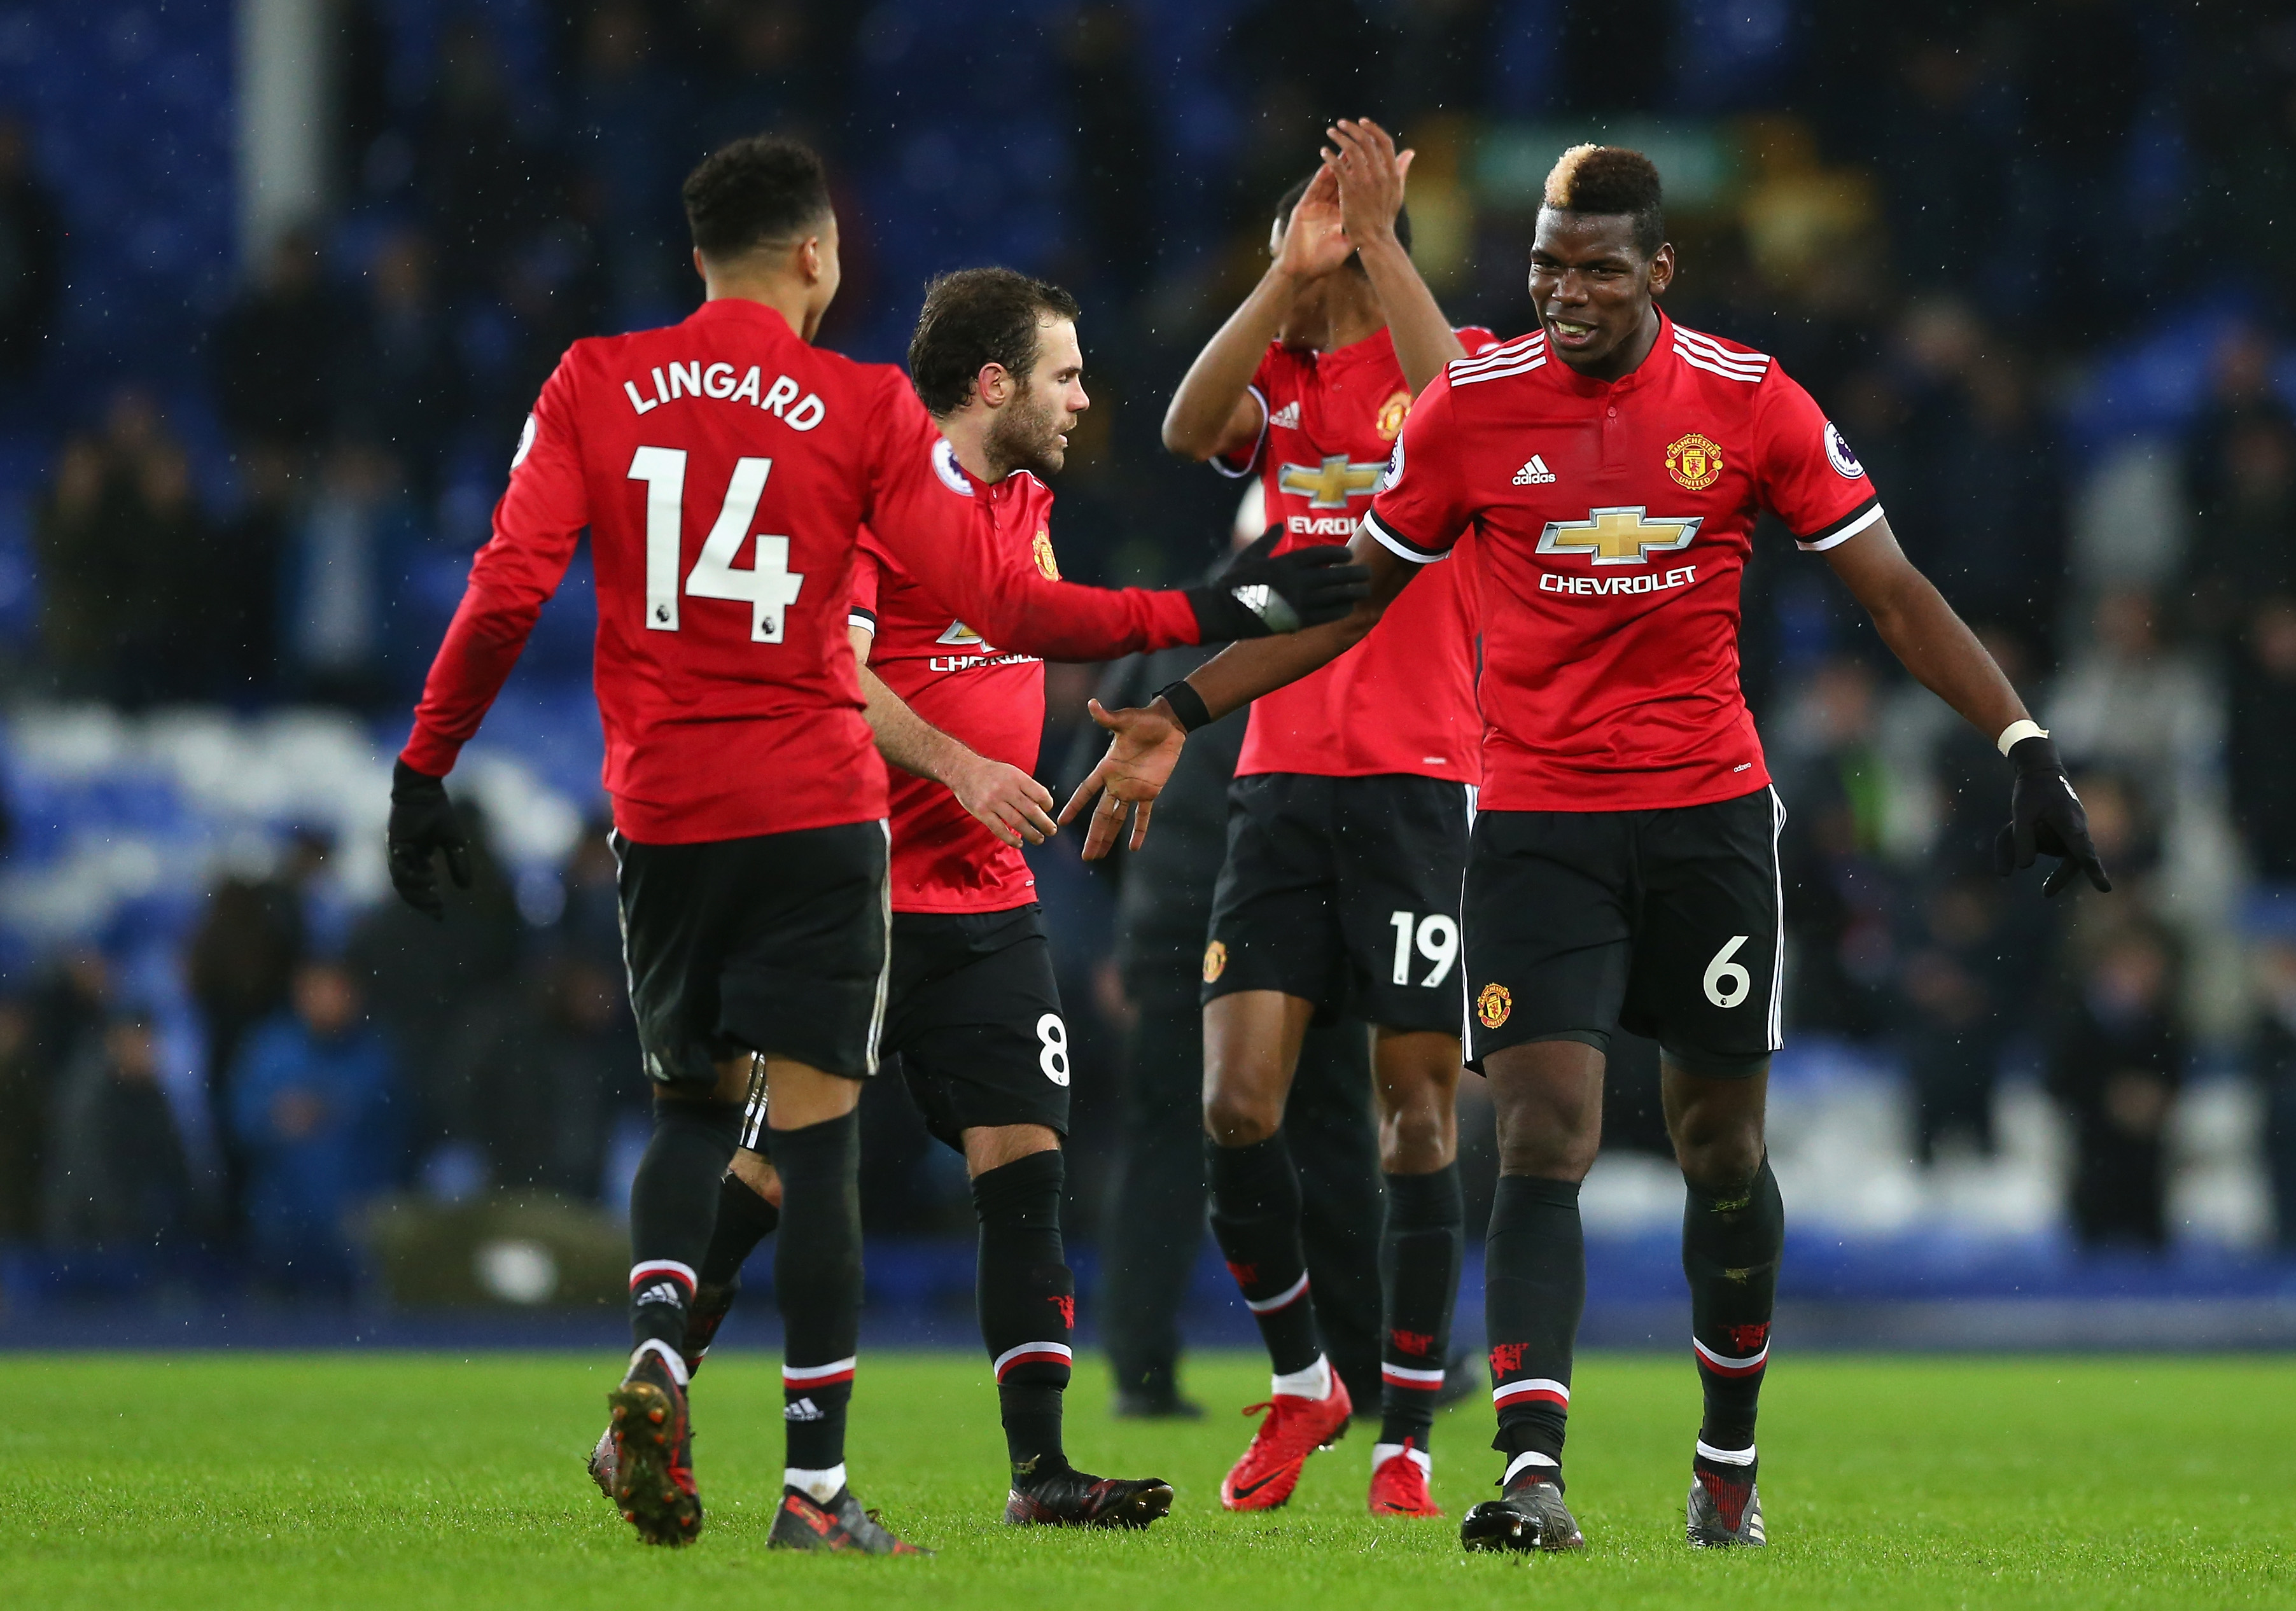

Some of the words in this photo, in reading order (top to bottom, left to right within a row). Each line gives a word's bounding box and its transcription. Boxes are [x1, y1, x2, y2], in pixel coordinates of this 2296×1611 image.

[624, 360, 825, 431] LINGARD
[1671, 437, 1717, 456] MANCHESTER
[1512, 473, 1557, 485] adidas
[1678, 476, 1711, 486] UNITED
[1287, 515, 1357, 535] EVROL
[627, 445, 804, 644] 14
[1539, 565, 1697, 595] CHEVROLET
[1390, 910, 1459, 987] 19
[1704, 935, 1751, 1008] 6
[1487, 1014, 1506, 1026] UNITED
[1037, 1013, 1070, 1087] 8
